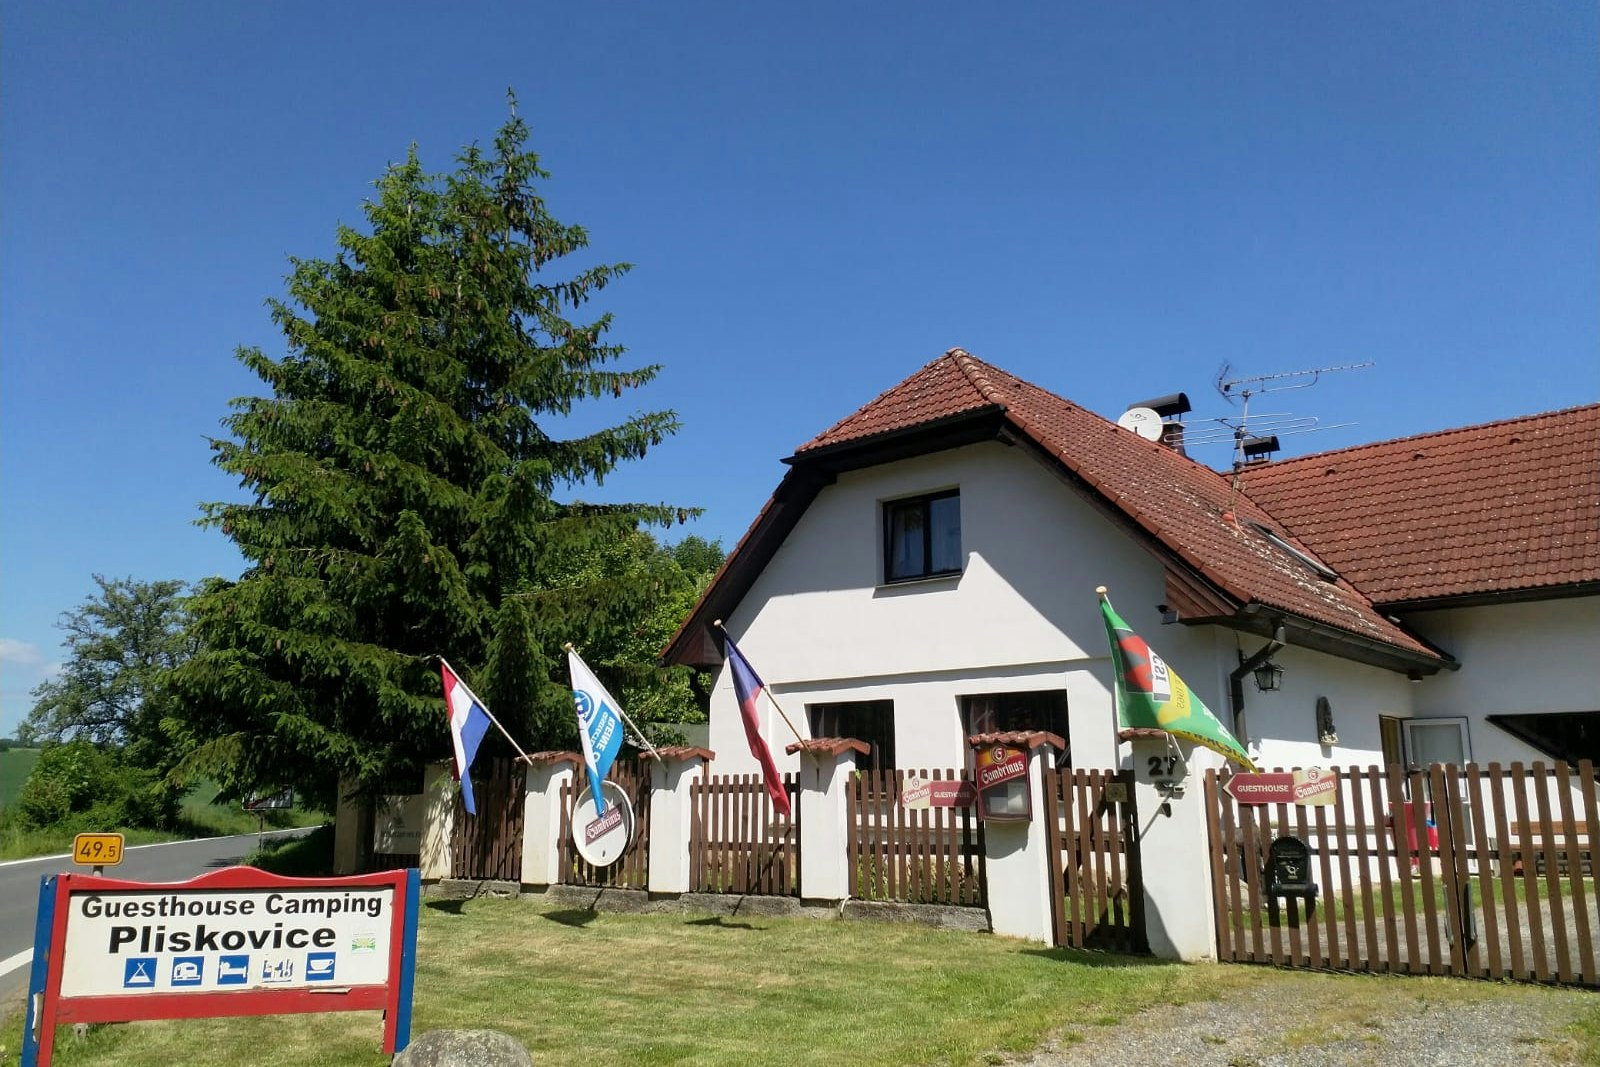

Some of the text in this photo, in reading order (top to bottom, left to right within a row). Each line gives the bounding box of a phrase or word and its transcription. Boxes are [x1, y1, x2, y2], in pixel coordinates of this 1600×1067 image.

[981, 759, 1024, 785] Gambrinus
[1147, 756, 1177, 776] 27
[1237, 785, 1289, 793] GUESTHOUSE
[1295, 780, 1335, 798] Gambrinus
[79, 841, 116, 859] 49.5
[81, 893, 382, 918] Guesthouse Camping
[109, 922, 336, 954] Pliskovice
